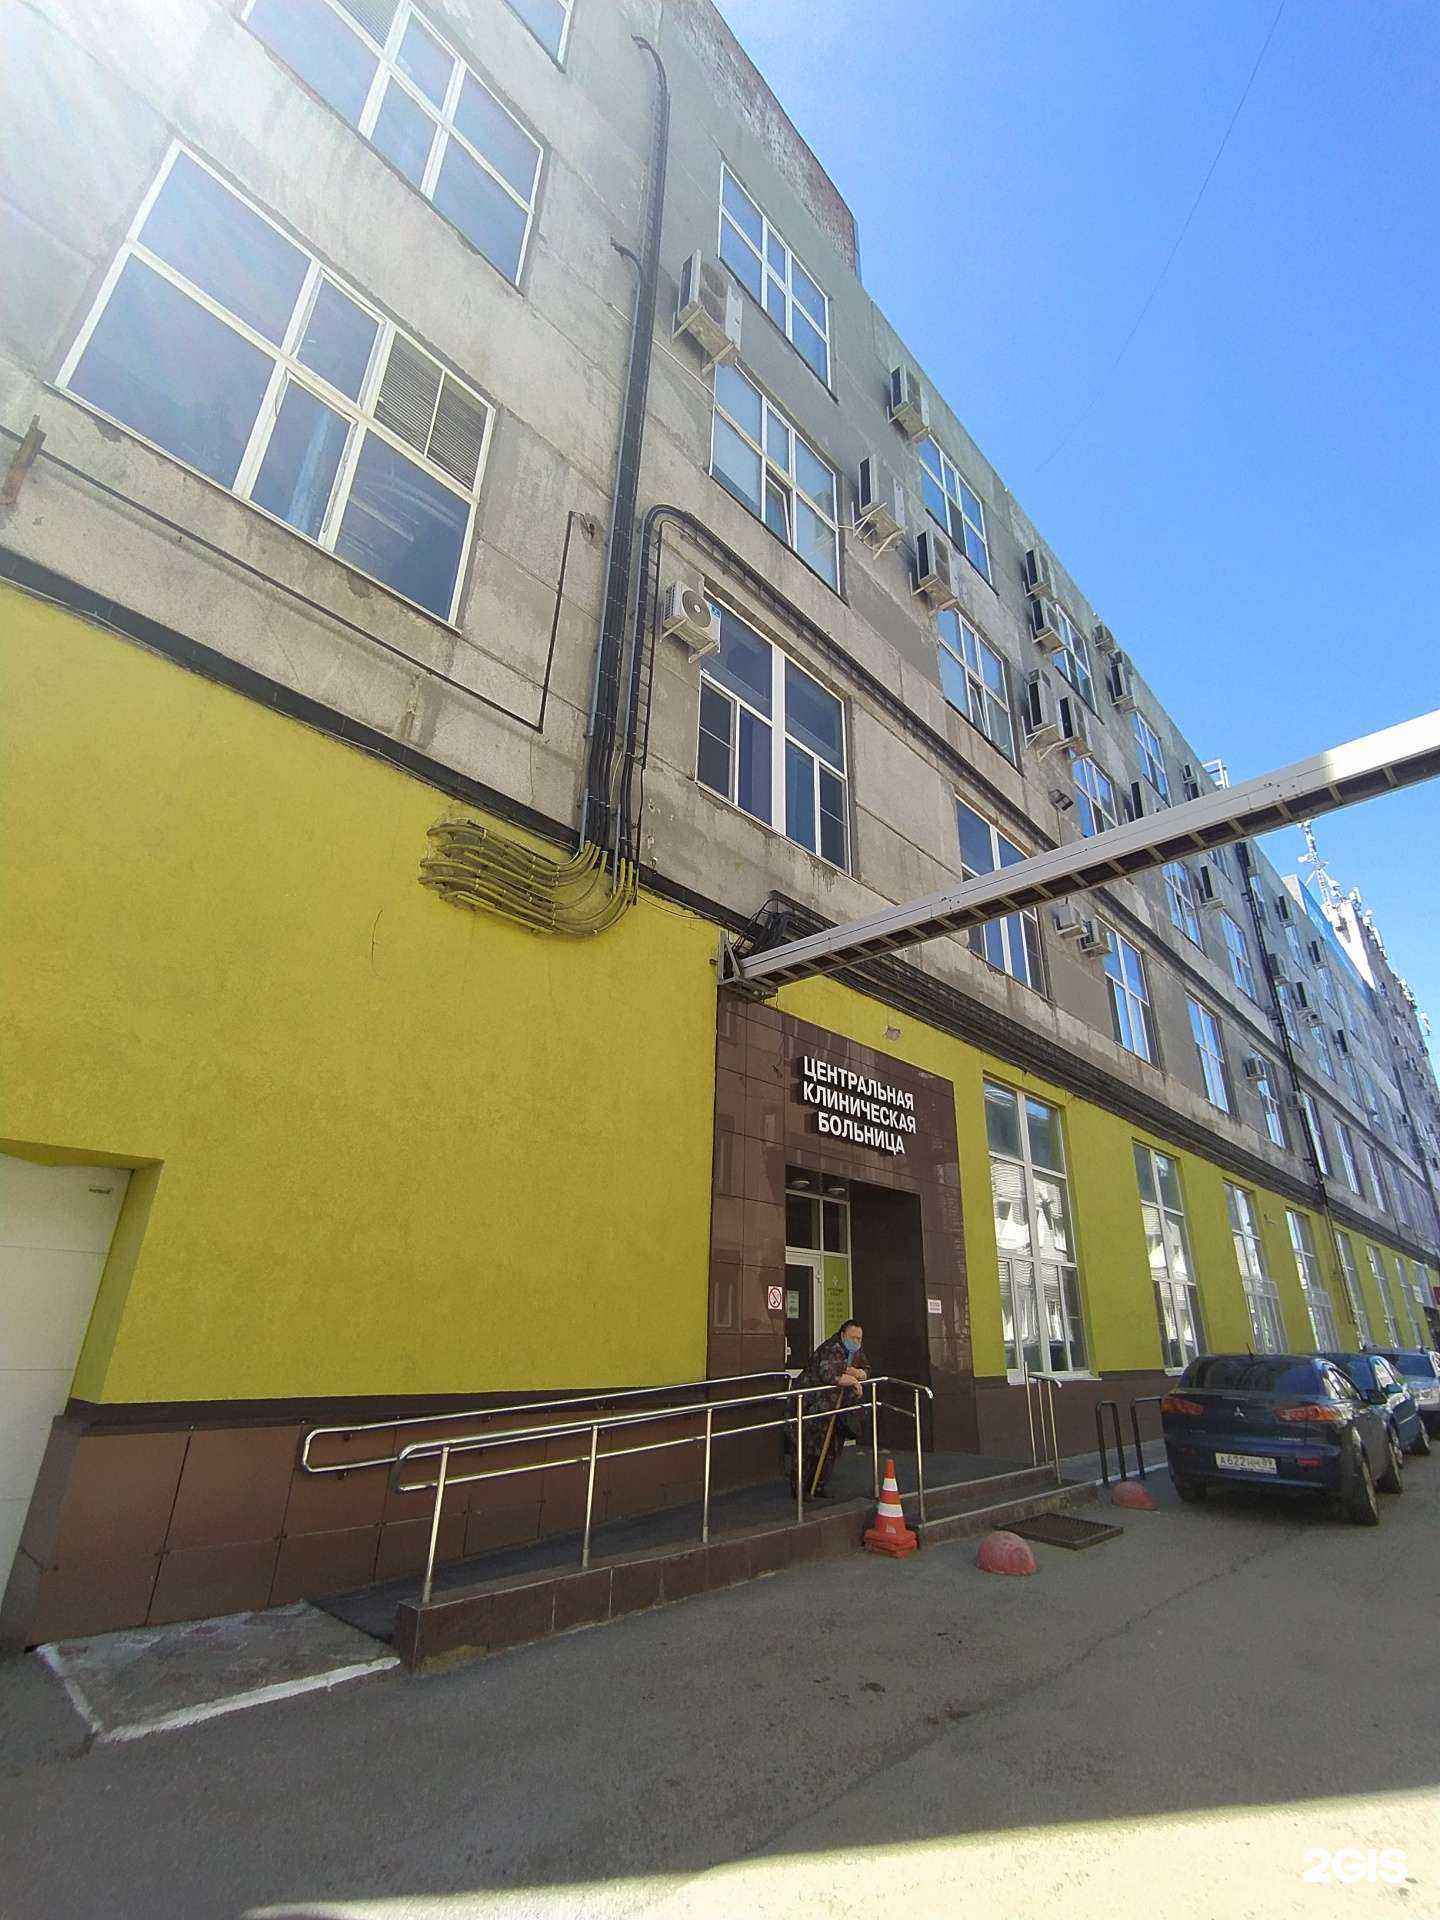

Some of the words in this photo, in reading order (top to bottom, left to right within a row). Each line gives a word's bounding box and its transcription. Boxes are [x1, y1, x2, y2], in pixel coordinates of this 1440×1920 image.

[803, 1056, 914, 1111] ЦЕНТРАЛЬНАЯ
[803, 1081, 917, 1134] КЛИНИЧЕСКАЯ
[818, 1111, 906, 1155] БОЛЬНИЦА
